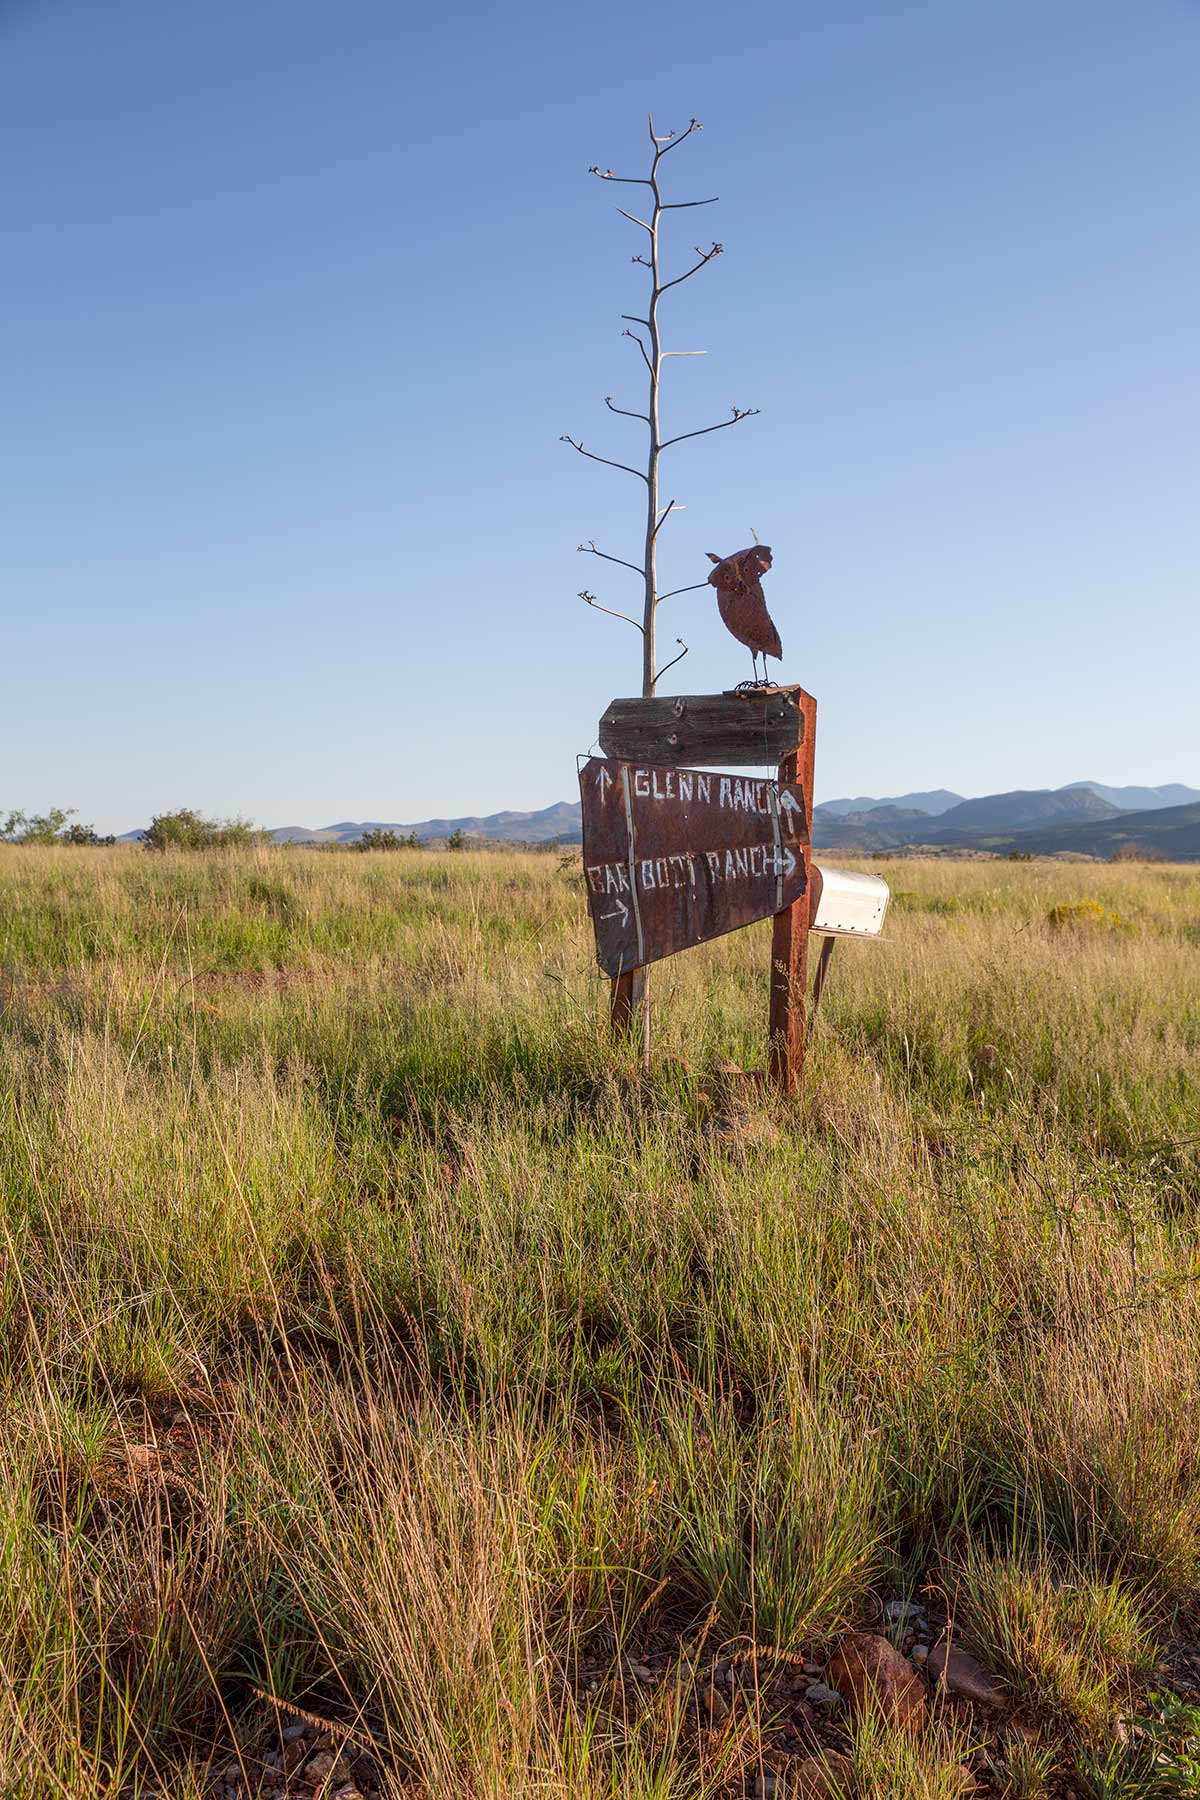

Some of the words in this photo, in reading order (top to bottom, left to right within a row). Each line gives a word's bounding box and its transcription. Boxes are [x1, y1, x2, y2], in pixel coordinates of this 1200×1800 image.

[634, 770, 711, 804] GLENN
[587, 862, 630, 894] BAR
[705, 846, 780, 884] RANCH
